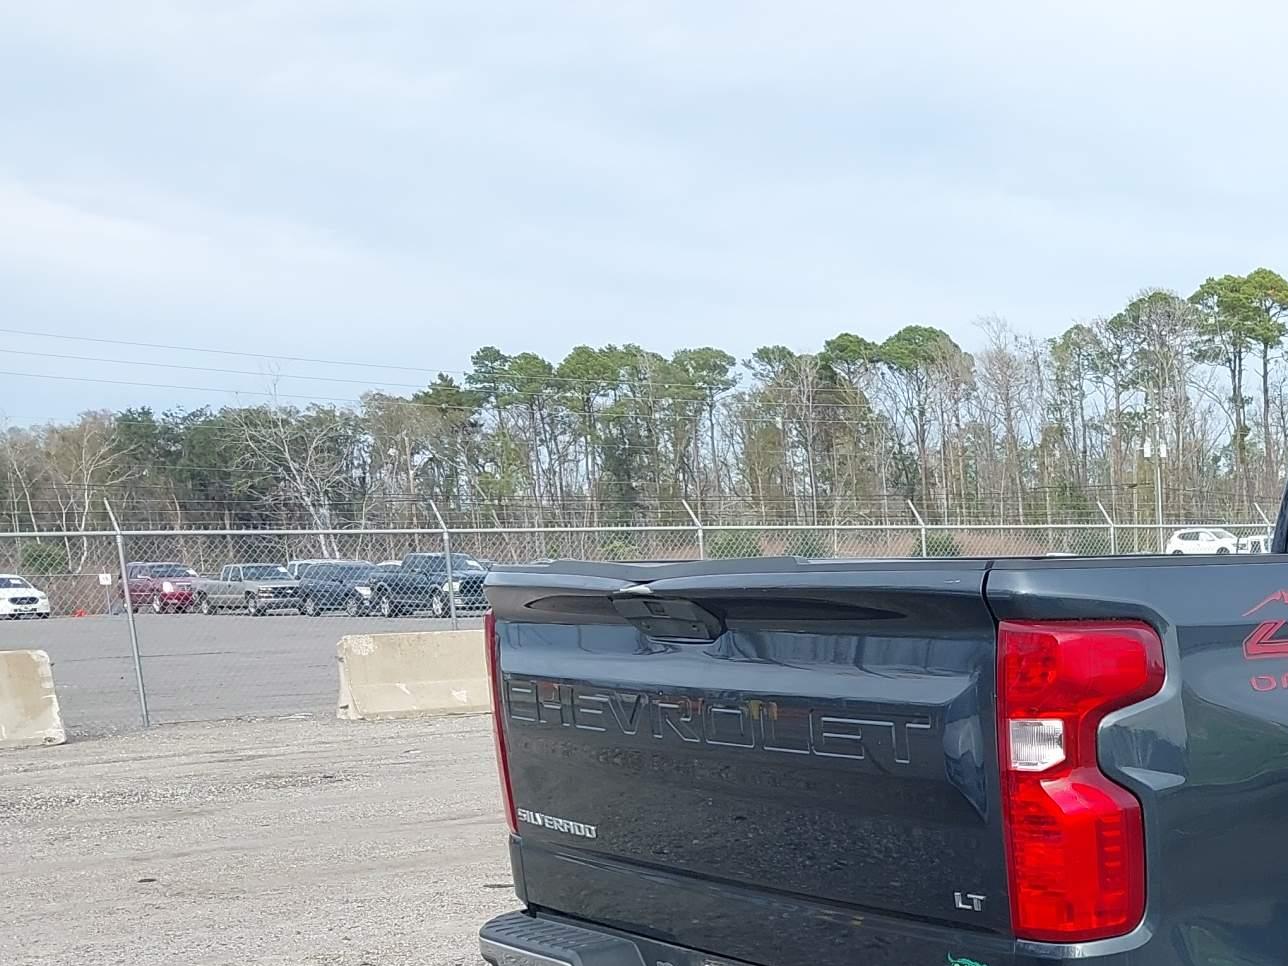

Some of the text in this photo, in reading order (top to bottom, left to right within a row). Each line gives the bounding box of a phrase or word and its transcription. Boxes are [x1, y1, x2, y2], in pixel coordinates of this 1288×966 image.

[506, 677, 933, 764] CHEVROLET
[517, 807, 597, 839] SILVERADO
[954, 892, 986, 912] LT
